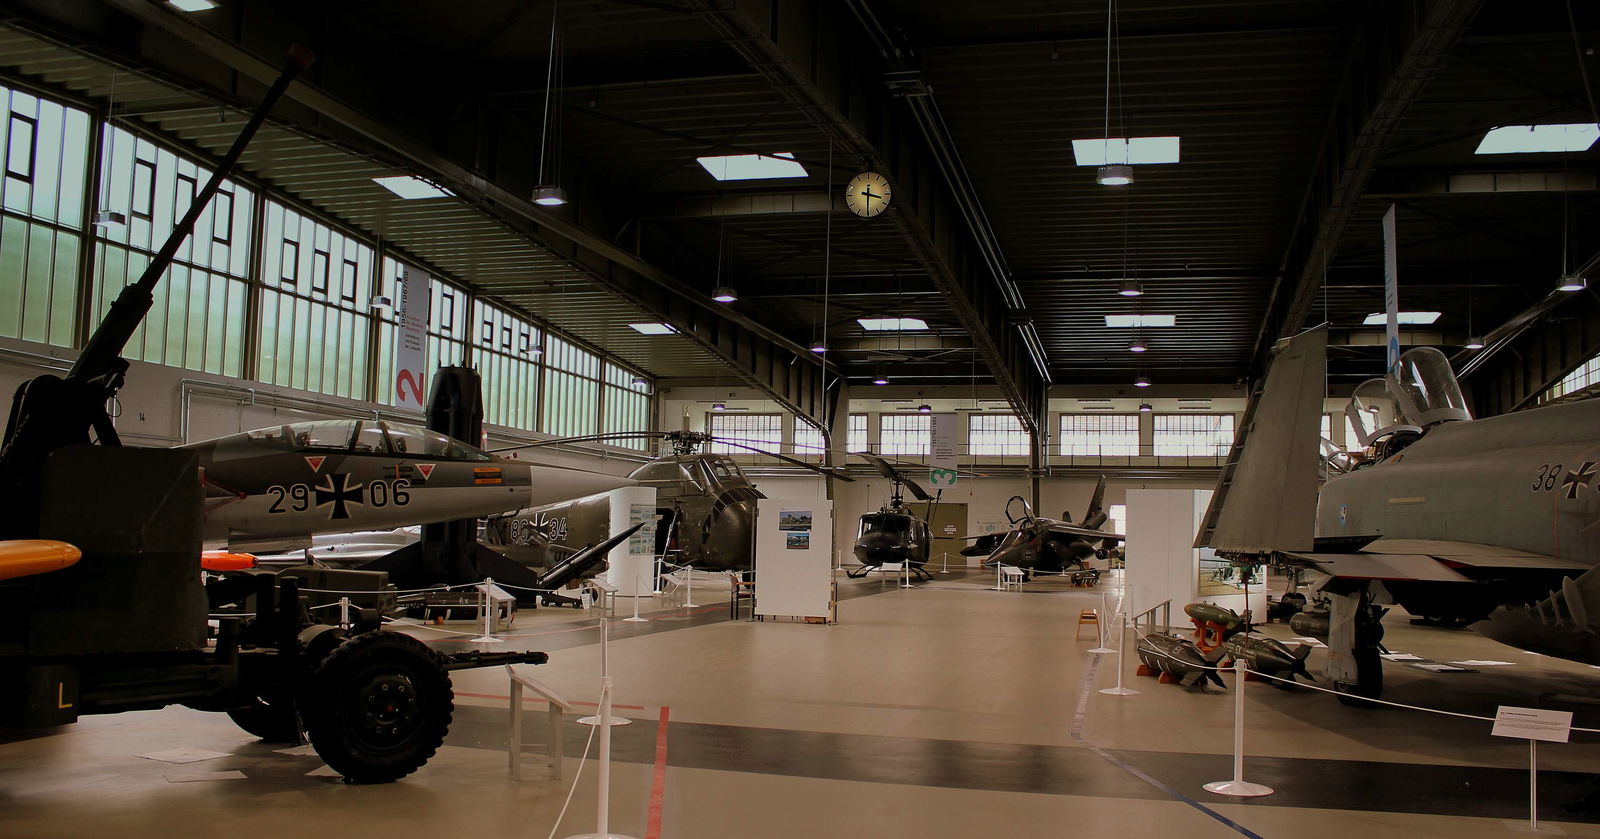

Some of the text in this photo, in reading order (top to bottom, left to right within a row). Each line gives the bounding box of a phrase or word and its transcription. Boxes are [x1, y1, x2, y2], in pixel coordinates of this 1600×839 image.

[396, 369, 424, 406] 2
[930, 468, 957, 486] 3
[1531, 463, 1563, 492] 38
[267, 482, 310, 514] 29
[369, 478, 411, 508] 06
[549, 517, 567, 541] 34
[56, 681, 73, 709] L
